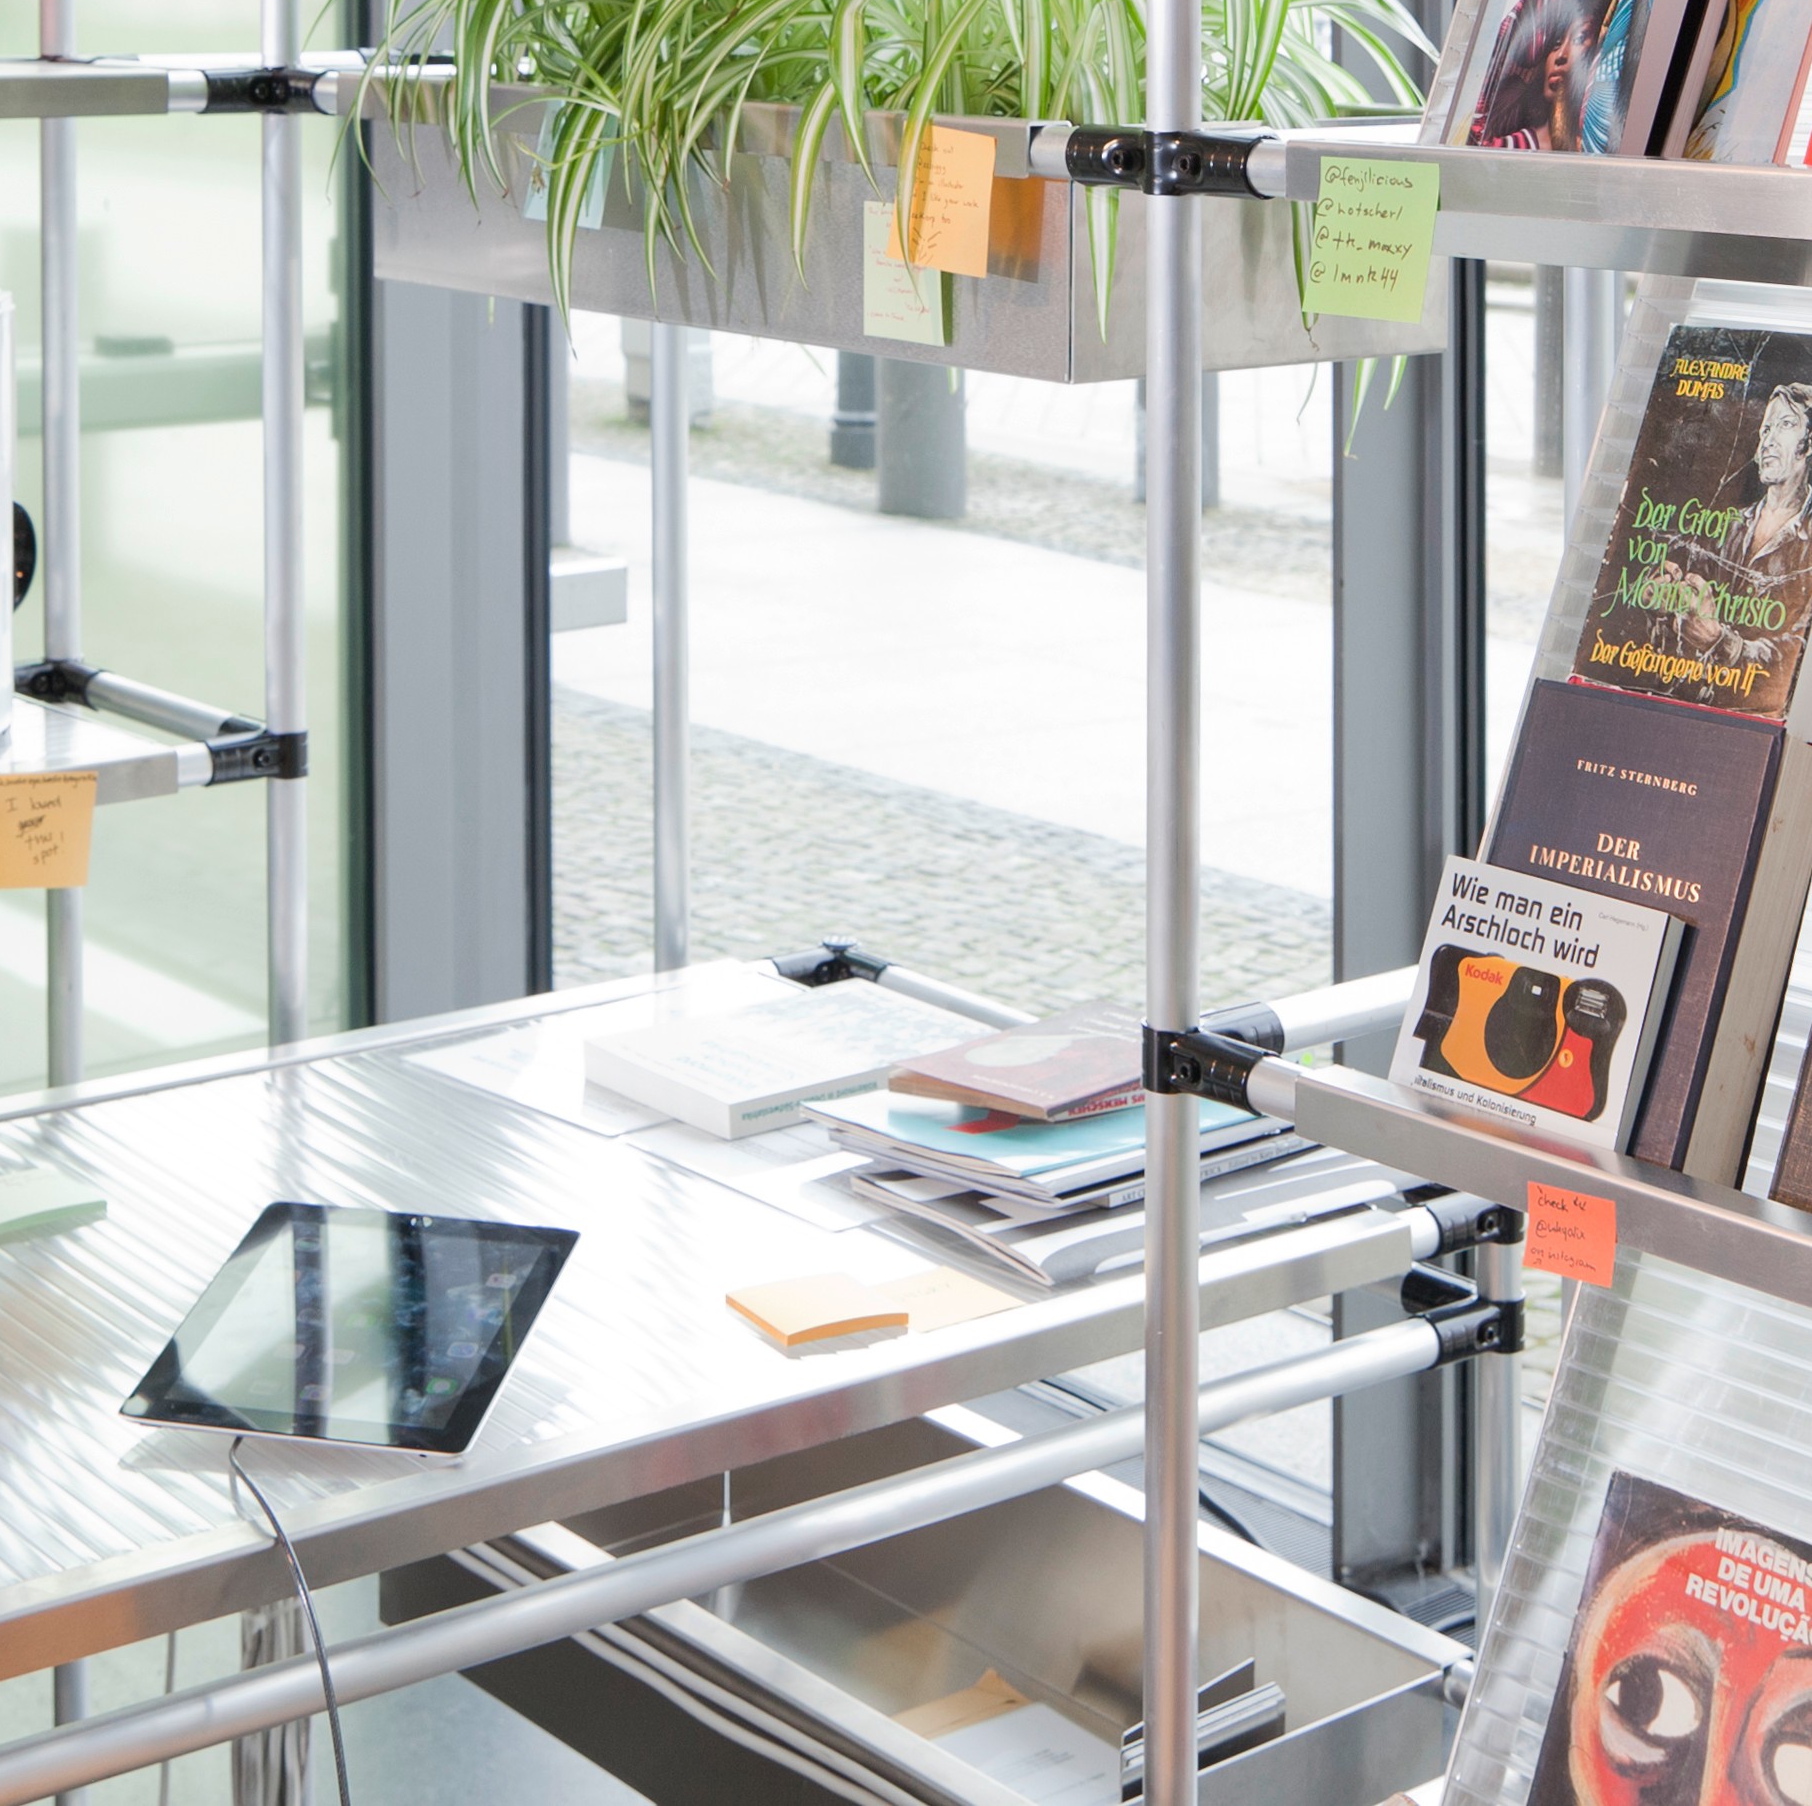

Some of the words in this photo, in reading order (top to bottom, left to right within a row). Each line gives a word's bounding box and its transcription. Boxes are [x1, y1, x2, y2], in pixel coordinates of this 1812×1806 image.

[1670, 358, 1750, 382] ALEXANDRE
[1676, 378, 1726, 400] DUMAS
[1633, 487, 1677, 531] Der
[1678, 498, 1744, 548] Graf
[1628, 535, 1668, 575] von
[1601, 567, 1693, 618] Monte
[1695, 579, 1788, 632] Christo
[1590, 629, 1617, 665] Der
[1619, 640, 1705, 684] Gefangene
[1707, 659, 1740, 687] von
[1577, 759, 1616, 777] FRITZ
[1620, 769, 1698, 796] STERNBERG
[1596, 832, 1640, 861] DER
[1529, 844, 1701, 903] IMPERIALISMUS
[1451, 873, 1489, 905] Wie
[1495, 891, 1543, 920] man
[1549, 902, 1584, 931] ein
[1441, 904, 1546, 954] Arschloch
[1553, 937, 1600, 968] wird
[1464, 963, 1504, 986] Kodak
[1457, 1090, 1475, 1103] und
[1476, 1095, 1537, 1126] Kolonisierung
[1717, 1557, 1751, 1590] DE
[1753, 1571, 1806, 1612] UMA
